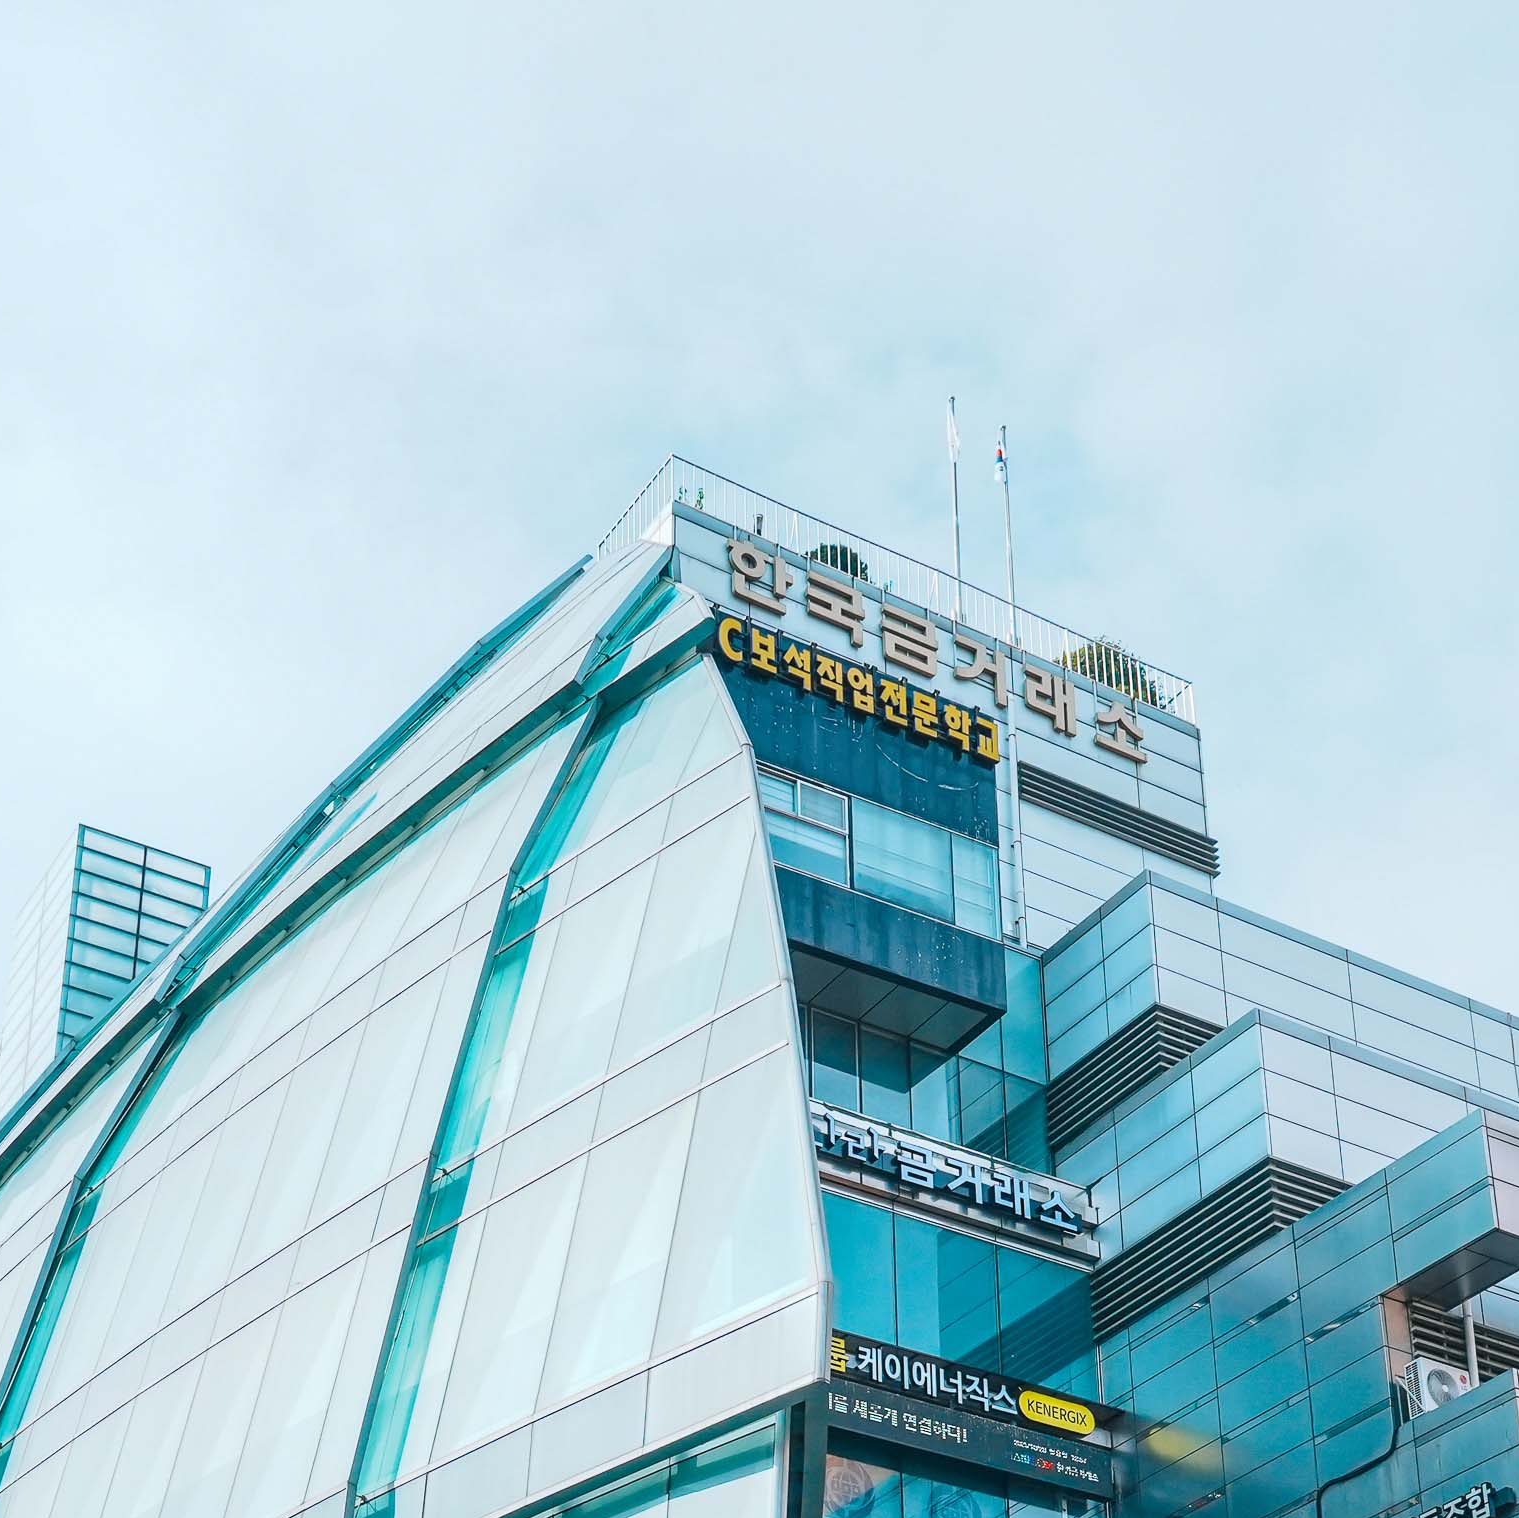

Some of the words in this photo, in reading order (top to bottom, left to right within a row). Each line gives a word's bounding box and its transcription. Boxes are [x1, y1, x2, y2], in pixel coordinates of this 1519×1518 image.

[719, 617, 1000, 764] C보석직업전문학교
[725, 538, 1148, 764] 한국금거래소
[858, 1345, 1017, 1415] 케이에너직스
[1027, 1398, 1087, 1427] KENERGIX
